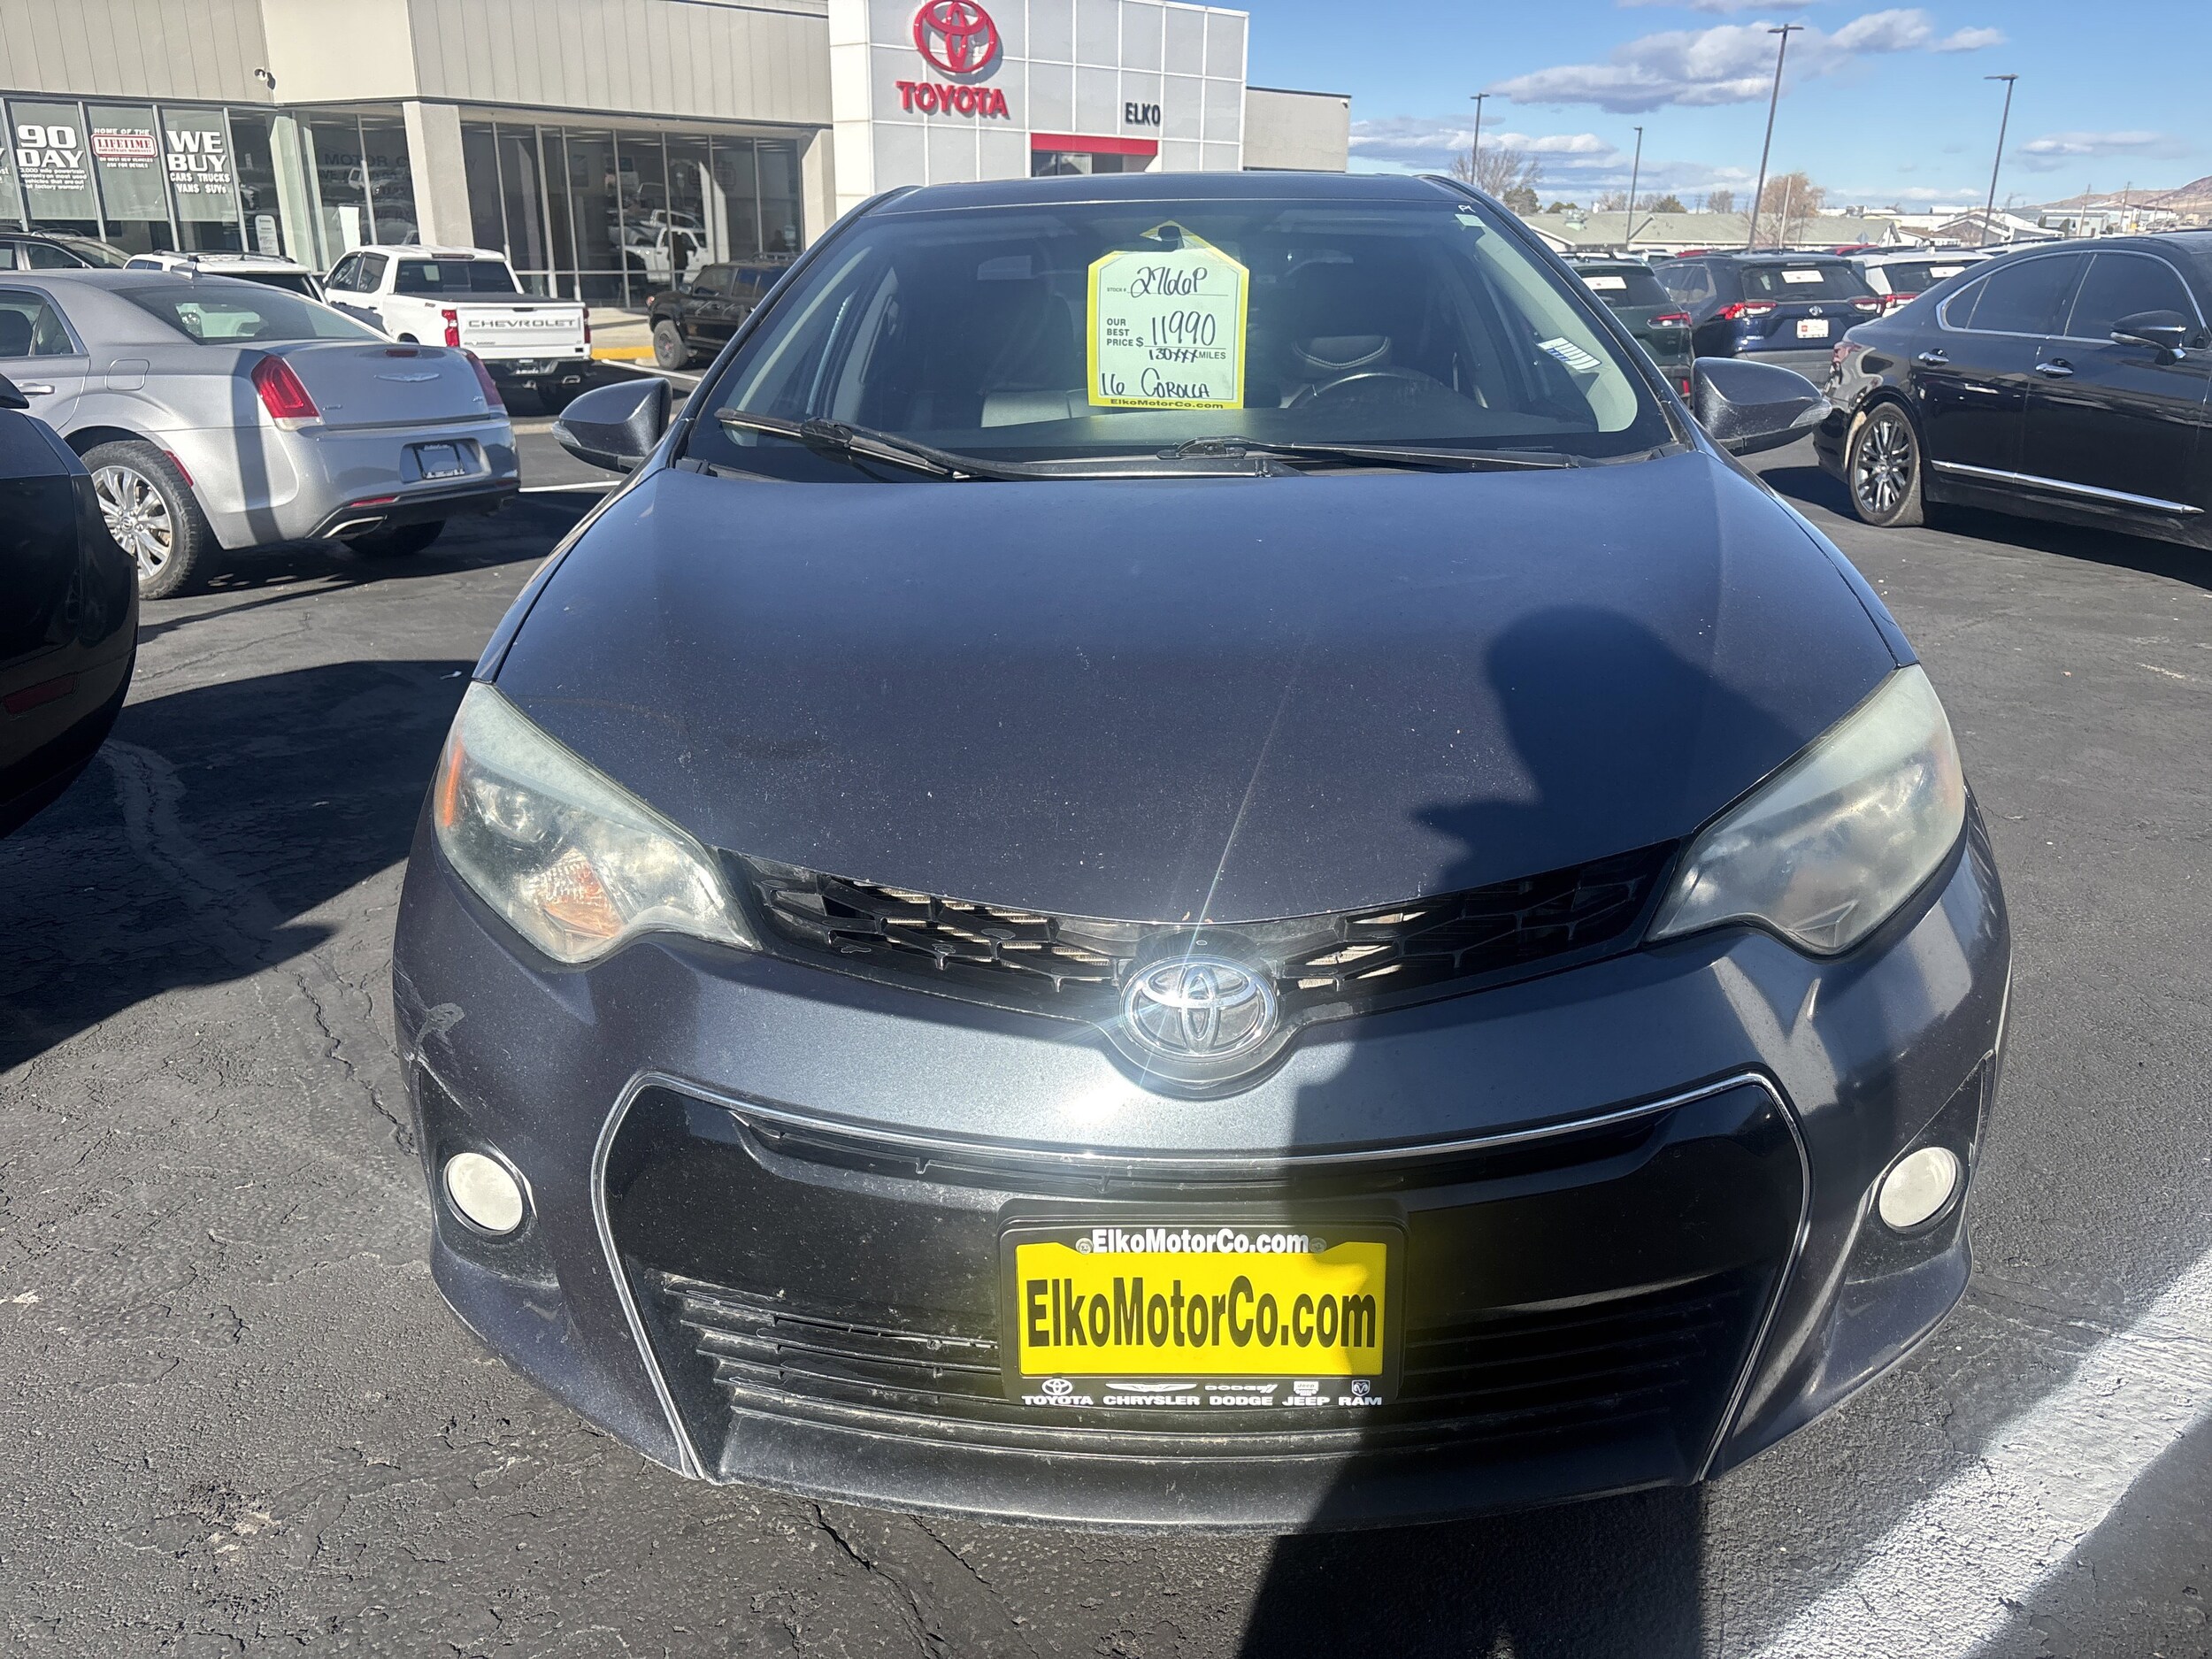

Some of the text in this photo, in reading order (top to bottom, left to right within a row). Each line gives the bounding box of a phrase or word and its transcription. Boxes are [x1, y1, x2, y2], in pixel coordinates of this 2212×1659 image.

[896, 81, 1009, 117] TOYOTA
[1125, 103, 1161, 125] ELKO
[18, 125, 77, 149] 90
[97, 139, 151, 148] LIFETIME
[166, 130, 224, 153] WE
[17, 149, 84, 168] DAY
[166, 154, 227, 173] BUY
[170, 173, 230, 182] CARS TRUCKS
[176, 183, 200, 193] VANS
[468, 319, 575, 328] CHEVROLET
[1107, 318, 1126, 326] OUR
[1107, 311, 1216, 347] PRICE $ 11990
[1107, 328, 1130, 337] BEST
[1102, 373, 1125, 396] 16
[1110, 398, 1224, 409] ElkoMotorCo.com
[1091, 1228, 1310, 1254] ElkoMotorCo.com
[1025, 1274, 1377, 1348] ElkoMotorCo.com
[1021, 1395, 1382, 1406] TOYOTA CHRYSLER DODGE JEEP RAM
